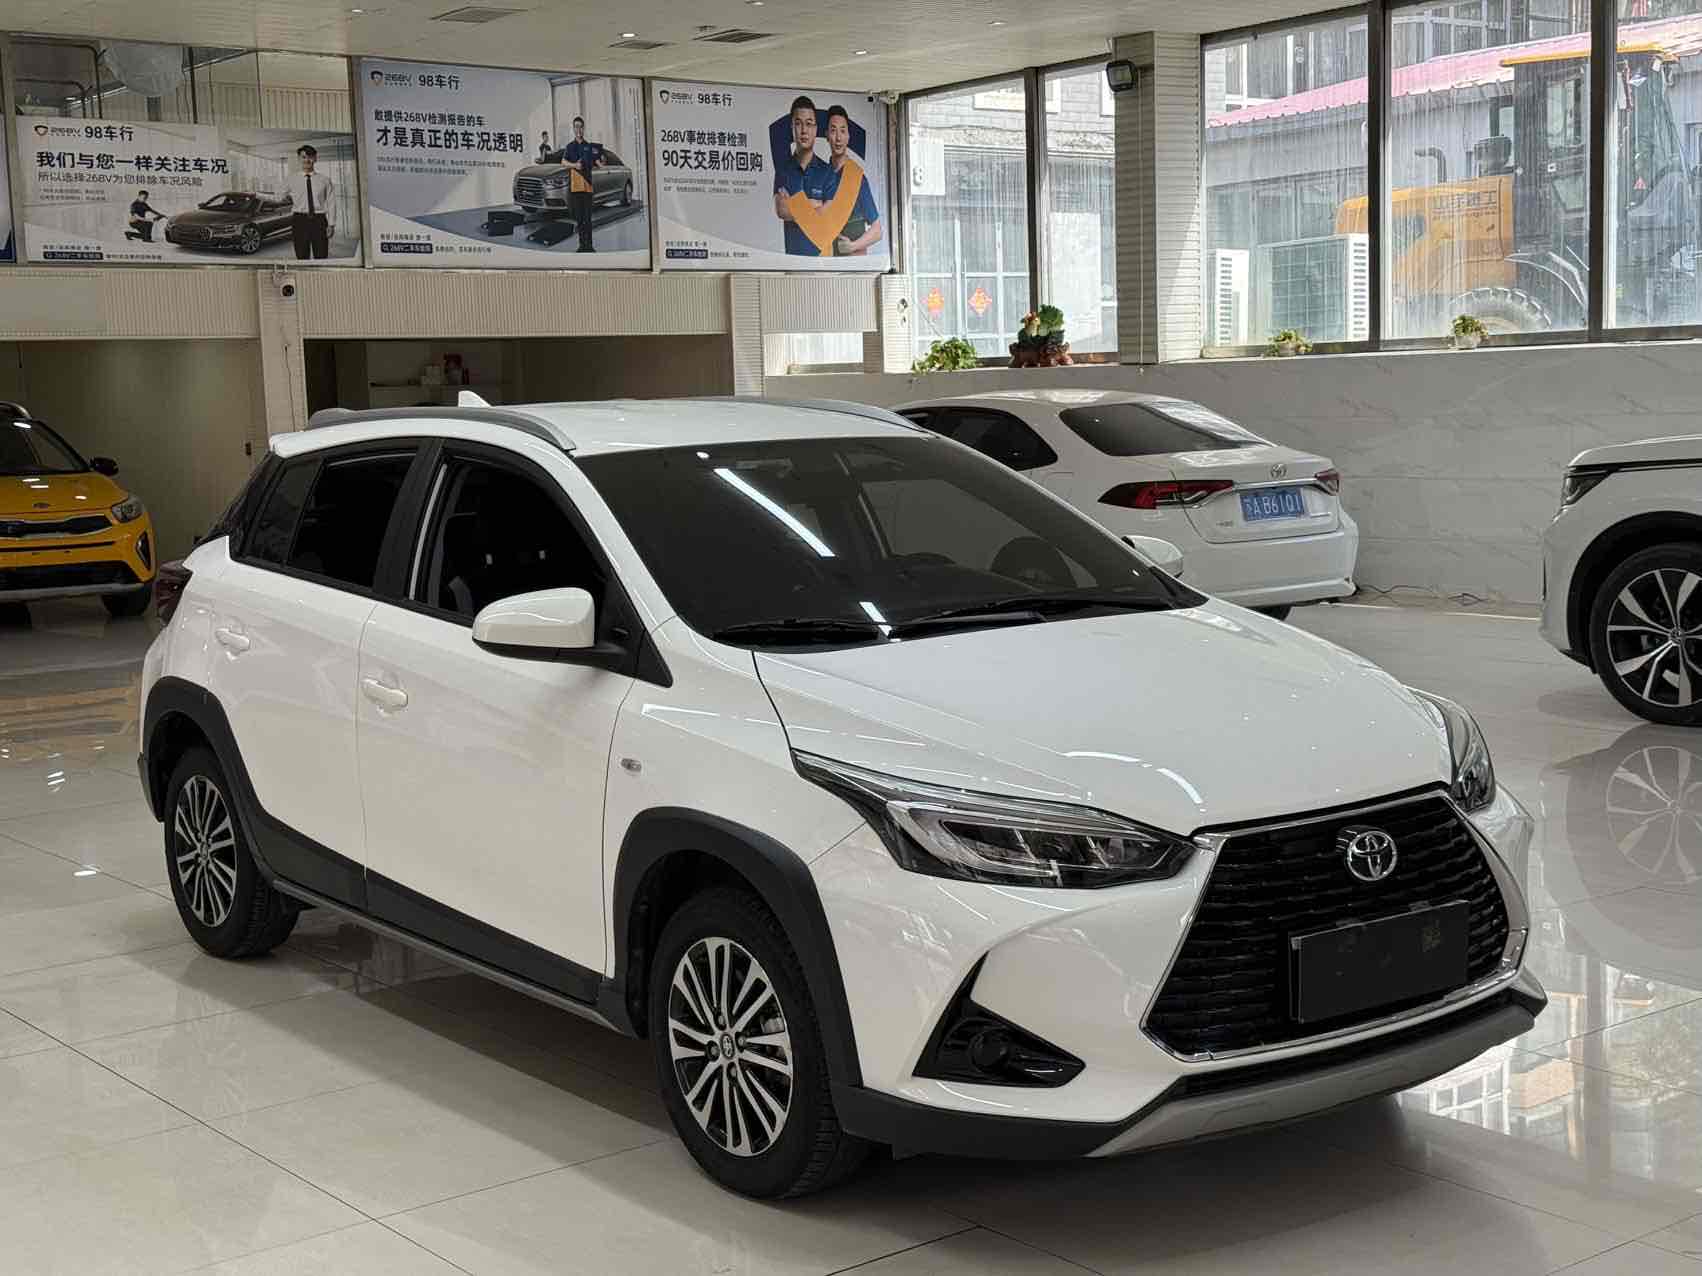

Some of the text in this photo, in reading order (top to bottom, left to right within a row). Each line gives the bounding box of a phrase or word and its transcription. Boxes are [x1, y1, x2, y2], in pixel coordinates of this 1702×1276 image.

[418, 75, 459, 90] 98车行
[697, 92, 733, 107] 98车行
[84, 125, 134, 142] 98车行
[376, 126, 524, 153] 才是真正的车况透明
[660, 129, 747, 148] 268V事故排查检测
[36, 151, 229, 175] 我们与您一样关注车况
[662, 149, 763, 173] 90天交易价回购
[38, 171, 203, 188] 所以选择268V为您排除车况风险
